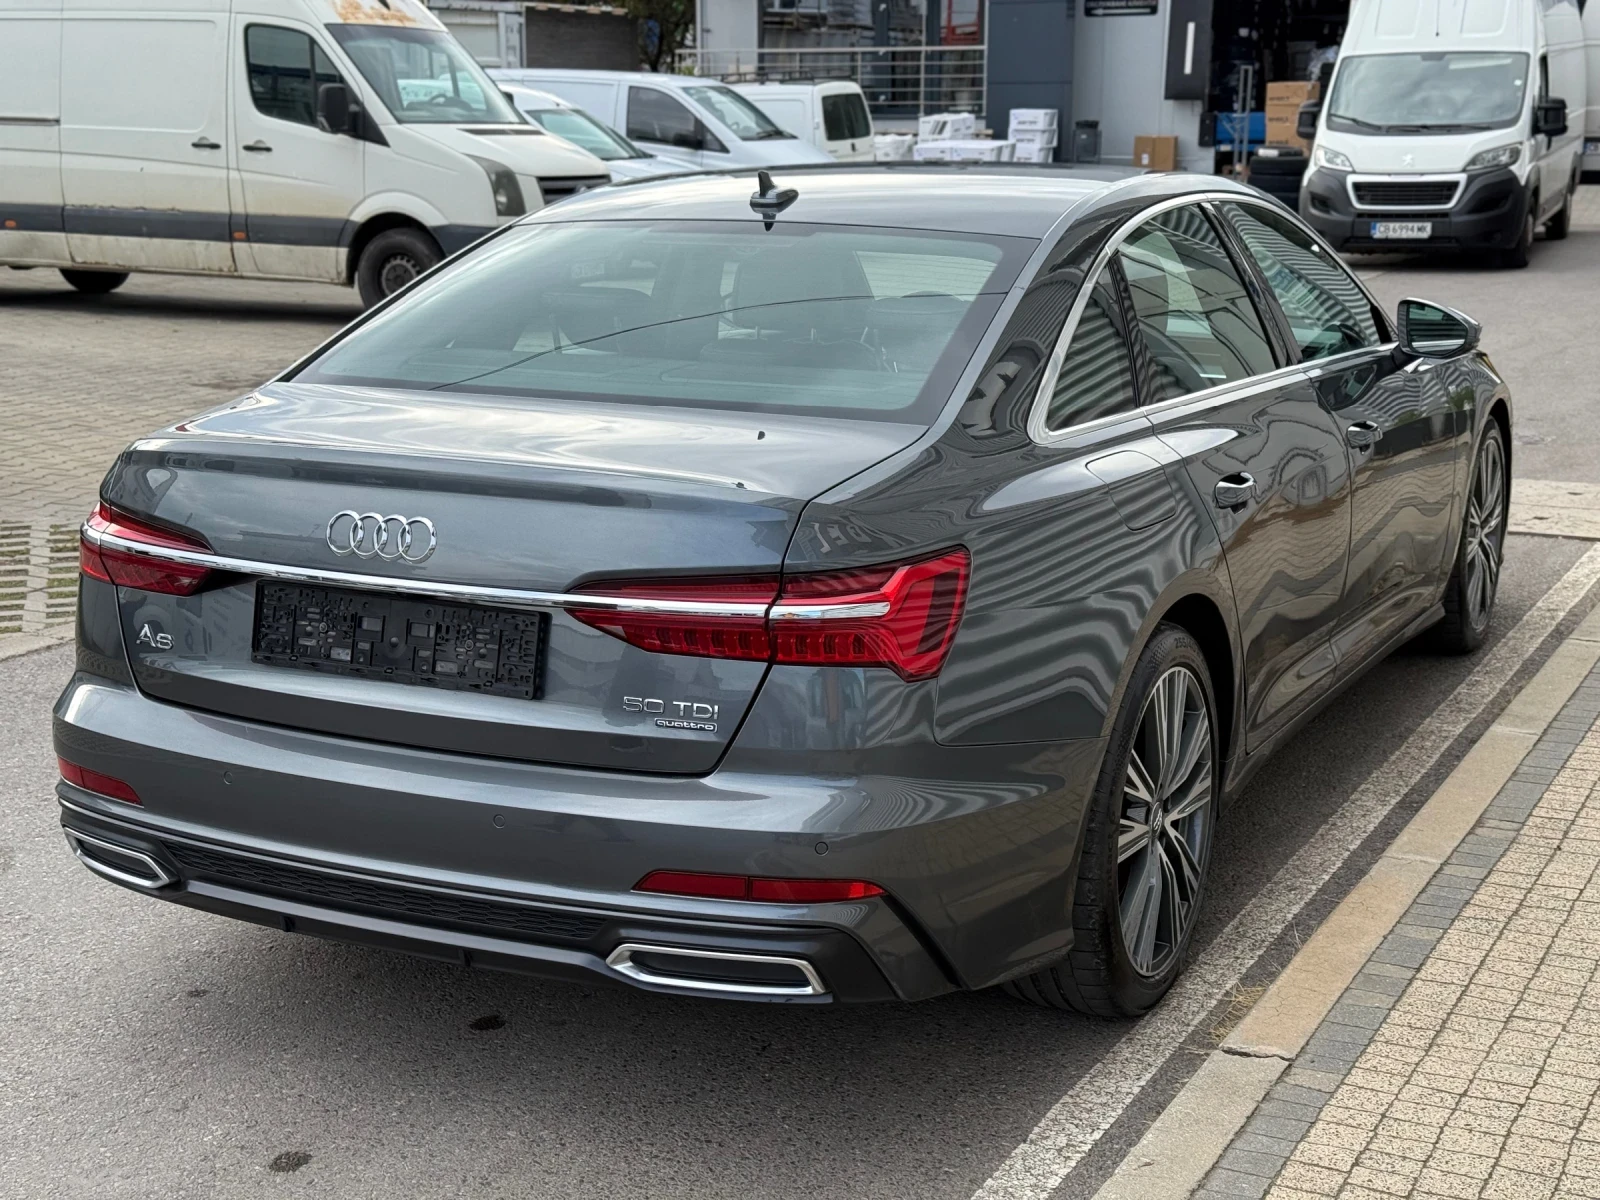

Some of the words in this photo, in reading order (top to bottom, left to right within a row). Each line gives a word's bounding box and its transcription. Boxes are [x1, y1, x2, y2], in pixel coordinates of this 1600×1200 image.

[1392, 224, 1415, 234] 6994
[136, 623, 174, 650] A6
[622, 696, 664, 713] 50
[673, 701, 719, 719] TDI
[657, 720, 714, 730] quattro
